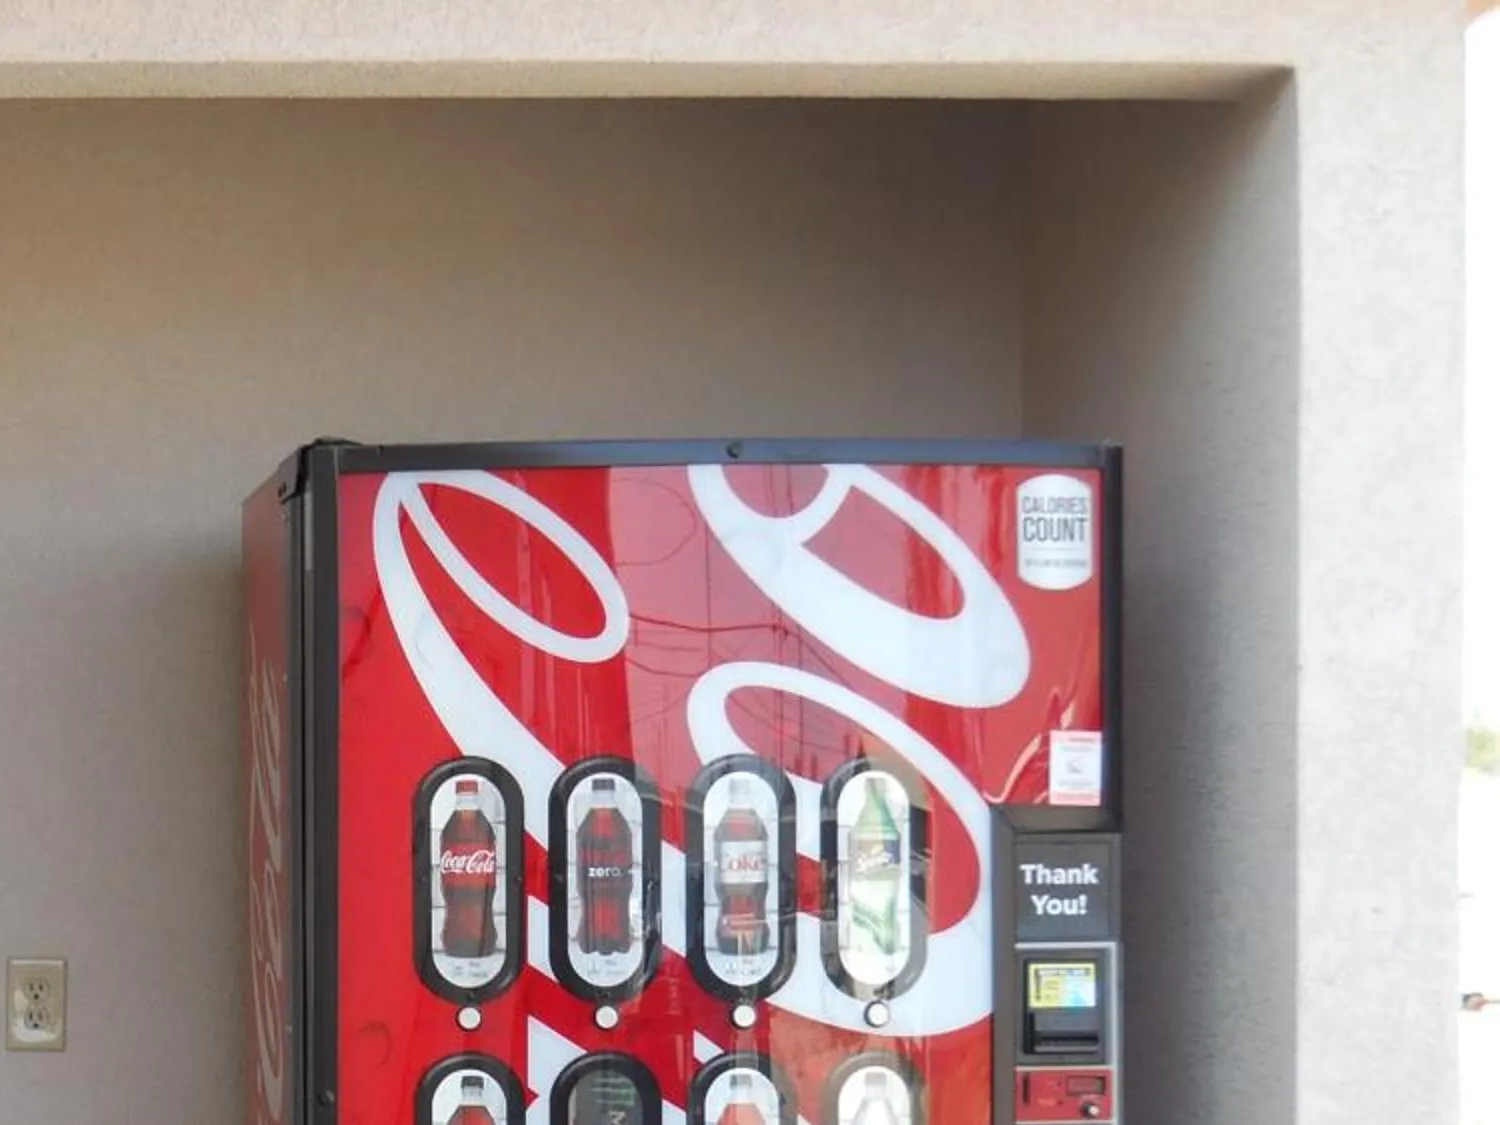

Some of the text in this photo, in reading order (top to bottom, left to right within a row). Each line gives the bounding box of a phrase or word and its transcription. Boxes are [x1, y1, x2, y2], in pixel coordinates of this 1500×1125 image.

[1022, 496, 1088, 514] CALORIES
[1022, 516, 1090, 543] COUNT
[440, 850, 496, 875] Coca-Cola
[1019, 863, 1099, 885] Thank
[1030, 894, 1088, 915] You!
